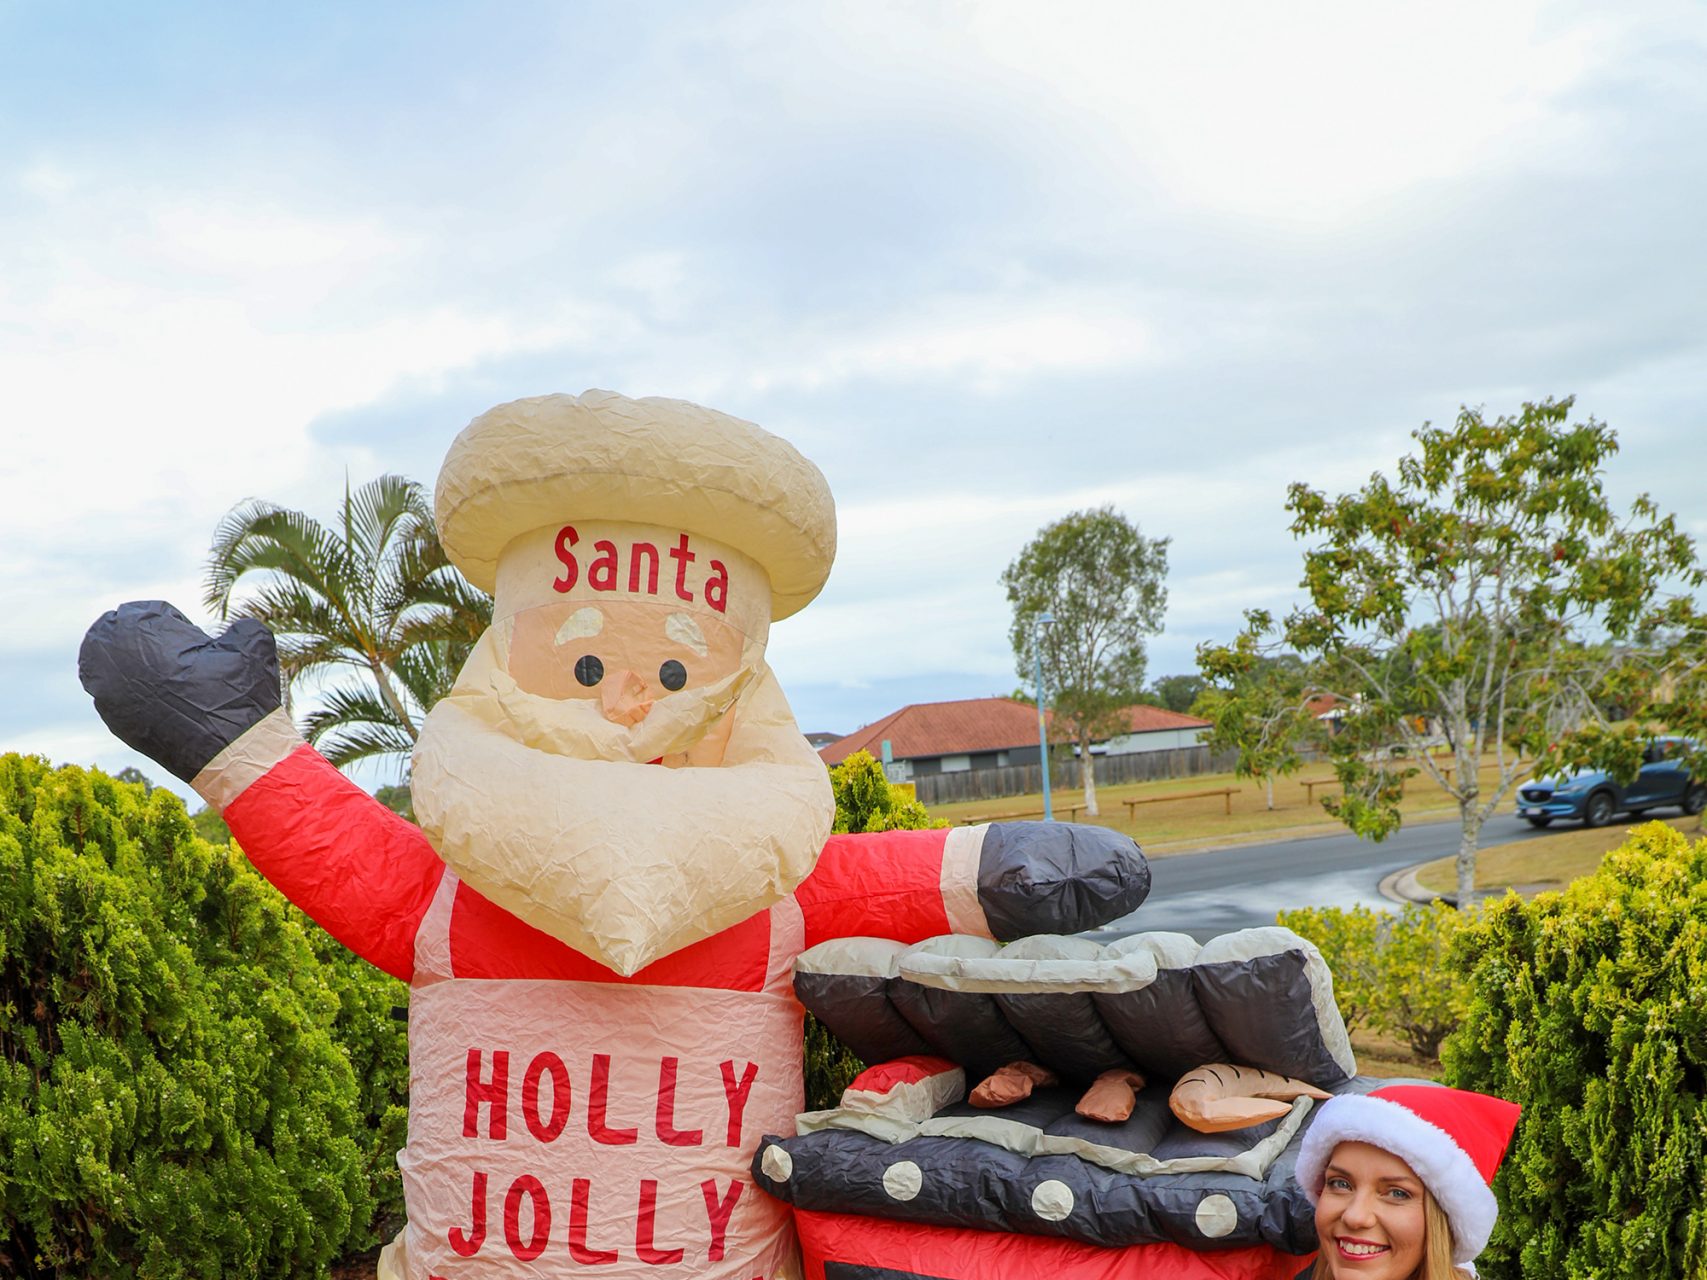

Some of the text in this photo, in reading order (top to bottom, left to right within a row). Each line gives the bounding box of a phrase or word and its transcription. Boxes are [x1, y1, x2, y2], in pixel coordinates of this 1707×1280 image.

[553, 525, 729, 614] Santa
[462, 1048, 759, 1148] HOLLY
[448, 1171, 744, 1265] JOLLY
